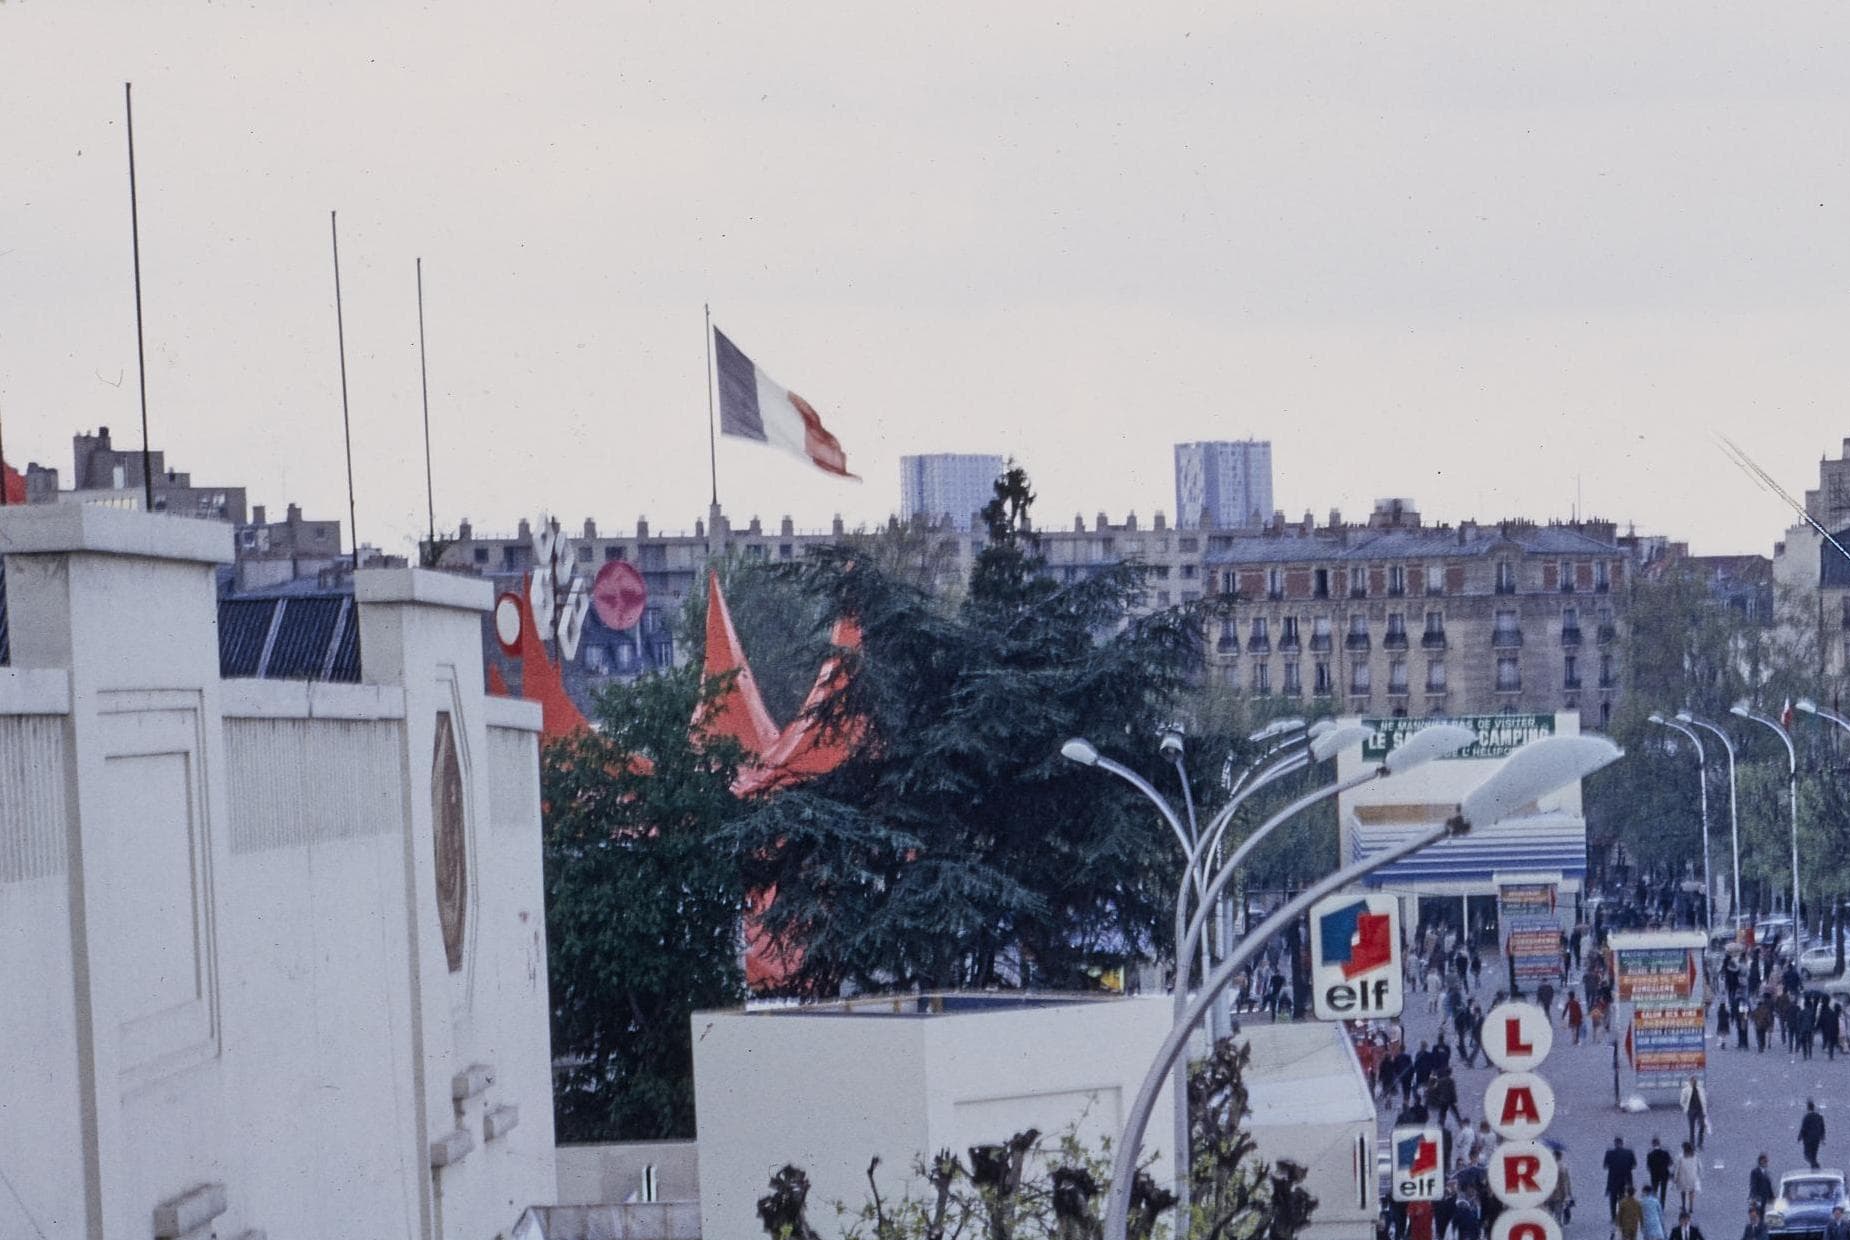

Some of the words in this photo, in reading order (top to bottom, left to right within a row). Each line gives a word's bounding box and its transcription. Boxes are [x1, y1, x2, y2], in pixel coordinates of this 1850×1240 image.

[1494, 717, 1536, 729] VISITER
[1367, 731, 1387, 750] LE
[1325, 979, 1389, 1013] elf
[1400, 1179, 1436, 1197] elf
